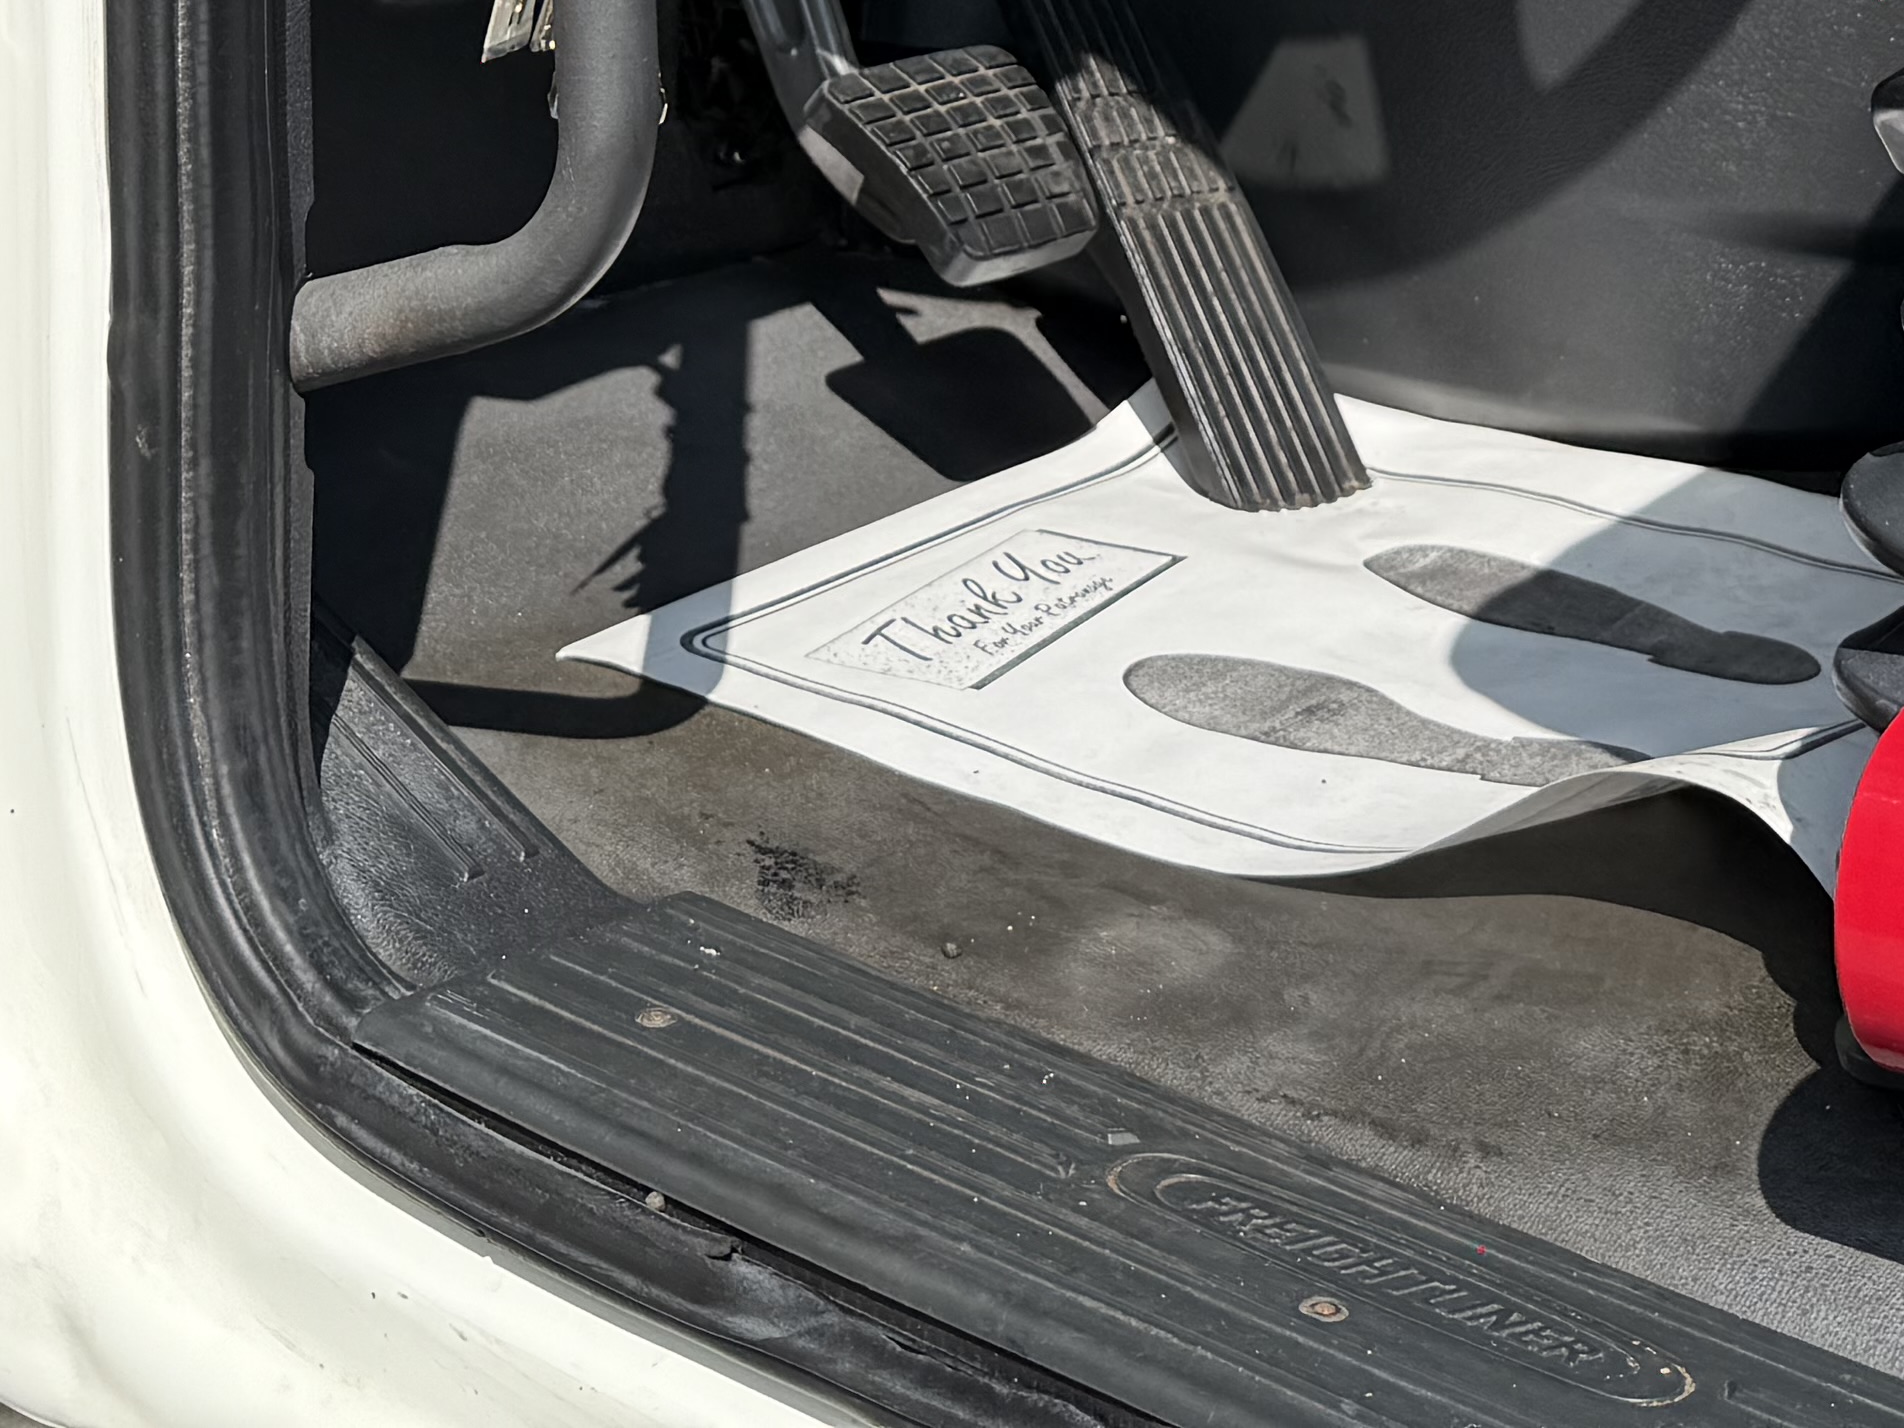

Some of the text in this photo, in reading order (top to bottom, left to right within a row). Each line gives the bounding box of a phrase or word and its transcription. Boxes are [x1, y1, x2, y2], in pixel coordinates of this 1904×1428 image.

[861, 577, 1022, 662] Thank
[973, 635, 1010, 657] For
[1002, 613, 1045, 644] Your
